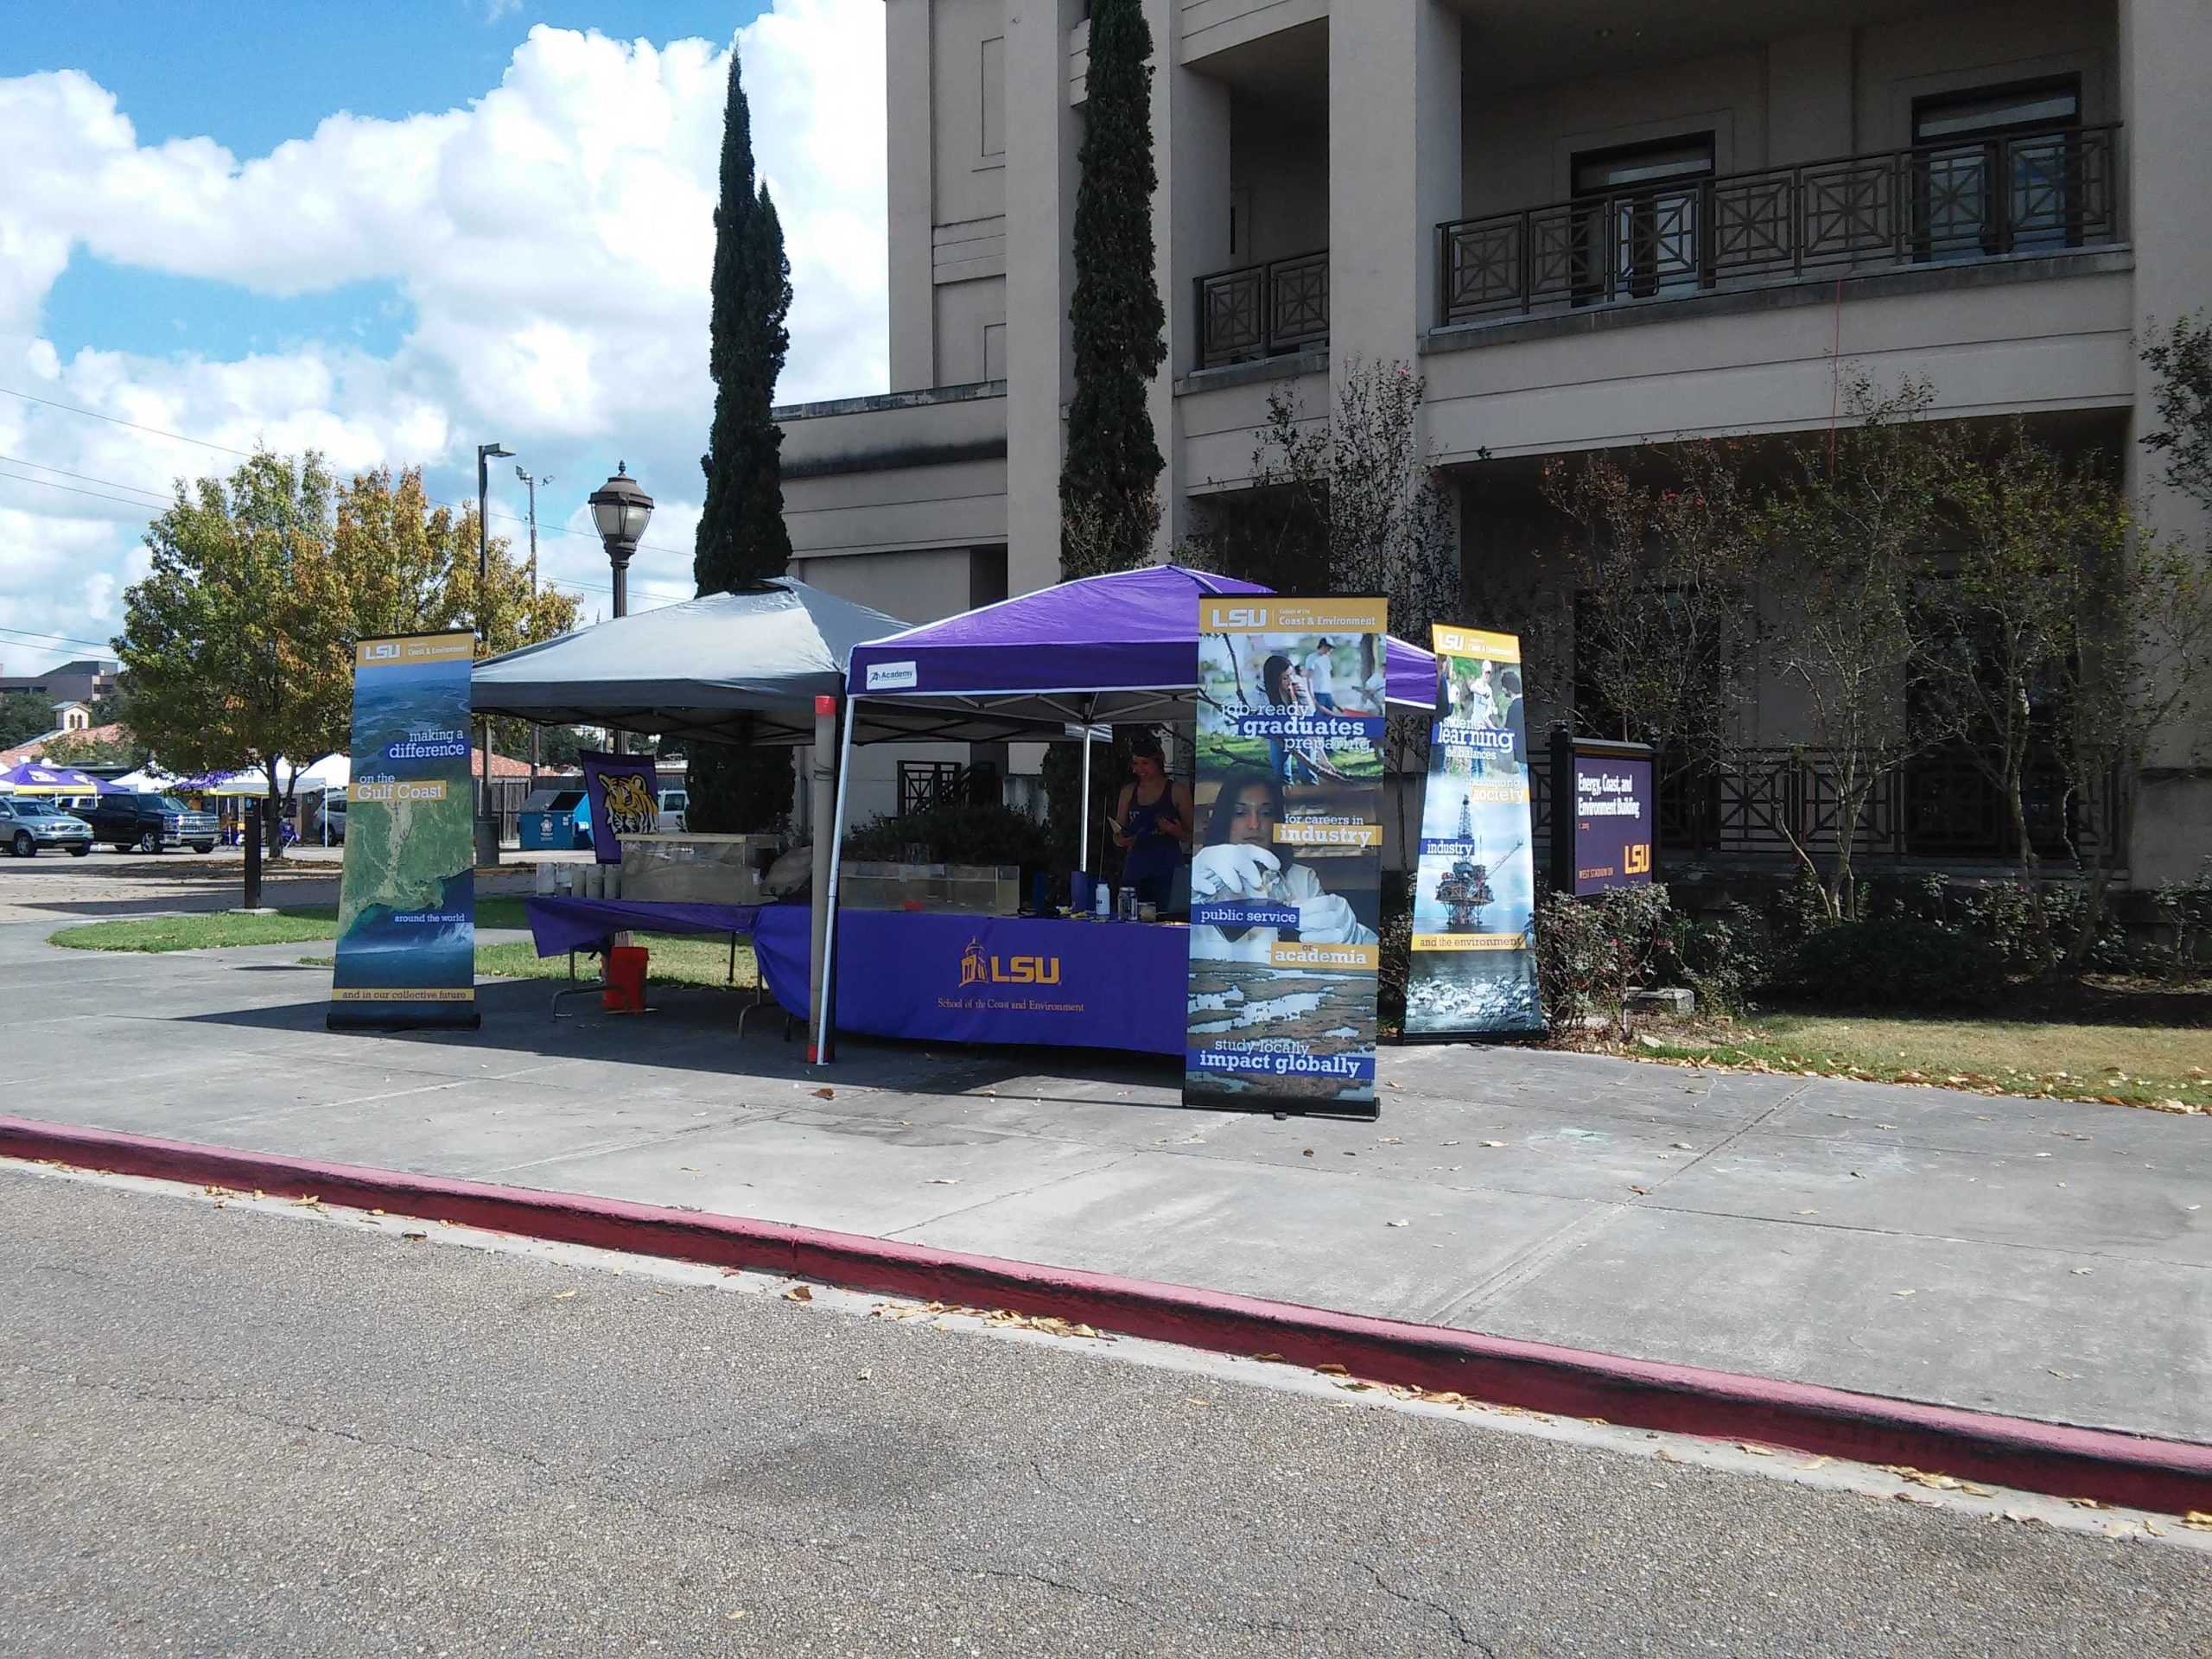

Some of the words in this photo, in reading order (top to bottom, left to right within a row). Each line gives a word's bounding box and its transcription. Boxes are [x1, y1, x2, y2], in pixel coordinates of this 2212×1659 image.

[1212, 608, 1267, 627] LSU
[1279, 616, 1306, 626] Coast
[1307, 617, 1314, 626] &
[1317, 616, 1375, 626] Environment
[1438, 632, 1465, 652] LSU
[365, 643, 401, 660] LSU
[881, 671, 912, 679] Academy
[1221, 701, 1309, 719] job-ready
[1243, 715, 1364, 739] graduates
[409, 729, 454, 742] making
[457, 730, 463, 740] a
[1437, 721, 1515, 753] learning
[389, 743, 465, 758] difference
[1283, 735, 1370, 753] preparing
[1459, 747, 1497, 760] balances
[359, 774, 375, 784] on
[378, 772, 395, 784] the
[1578, 772, 1602, 796] Energy,
[1603, 773, 1621, 795] Coast,
[1621, 774, 1632, 792] and
[358, 785, 394, 800] Gulf
[397, 785, 442, 799] Coast
[1471, 788, 1523, 803] society
[1578, 797, 1617, 816] Environment
[1618, 797, 1640, 818] Building
[1285, 814, 1301, 825] for
[1305, 816, 1350, 825] careers
[1352, 816, 1363, 825] in
[1280, 825, 1372, 848] industry
[1427, 841, 1473, 857] industry
[1624, 844, 1650, 874] LSU
[394, 914, 425, 923] around
[442, 913, 465, 922] world
[1200, 909, 1243, 923] public
[1246, 911, 1297, 923] service
[1420, 938, 1437, 947] and
[1439, 937, 1452, 947] the
[1454, 938, 1523, 948] environment
[1274, 948, 1368, 964] academia
[990, 956, 1060, 984] LSU
[938, 998, 963, 1008] School
[965, 998, 973, 1008] of
[976, 999, 985, 1008] the
[987, 999, 1010, 1009] Coast
[1012, 1000, 1027, 1009] and
[1029, 1000, 1084, 1012] Environment
[1215, 1039, 1255, 1054] study
[1259, 1039, 1310, 1058] locally
[1199, 1050, 1270, 1071] impact
[1275, 1054, 1361, 1077] globally
